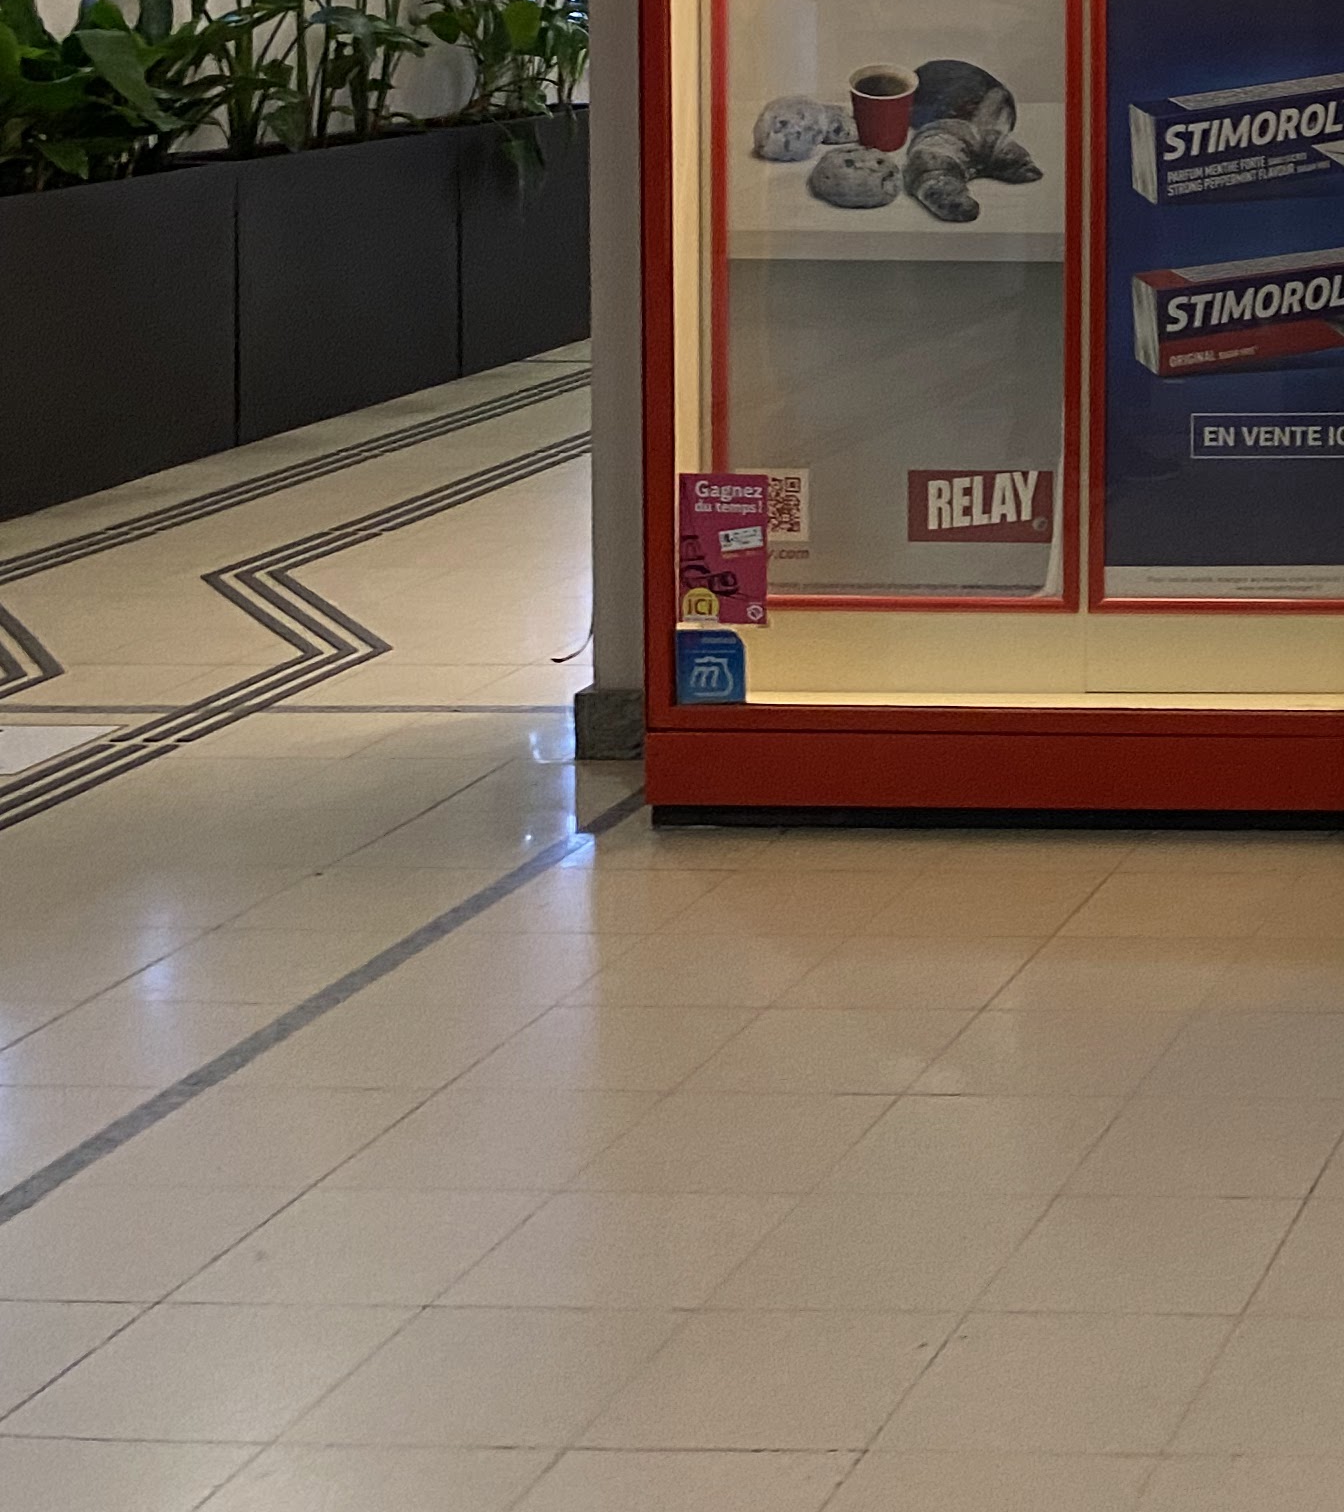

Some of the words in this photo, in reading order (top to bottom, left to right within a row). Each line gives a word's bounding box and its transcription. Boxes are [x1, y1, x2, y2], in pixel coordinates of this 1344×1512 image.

[1163, 101, 1344, 161] STIMOROL
[1203, 426, 1235, 447] EN
[1241, 426, 1322, 447] VENTE
[695, 480, 763, 502] Gagnez
[927, 470, 1039, 531] RELAY
[694, 499, 712, 513] du
